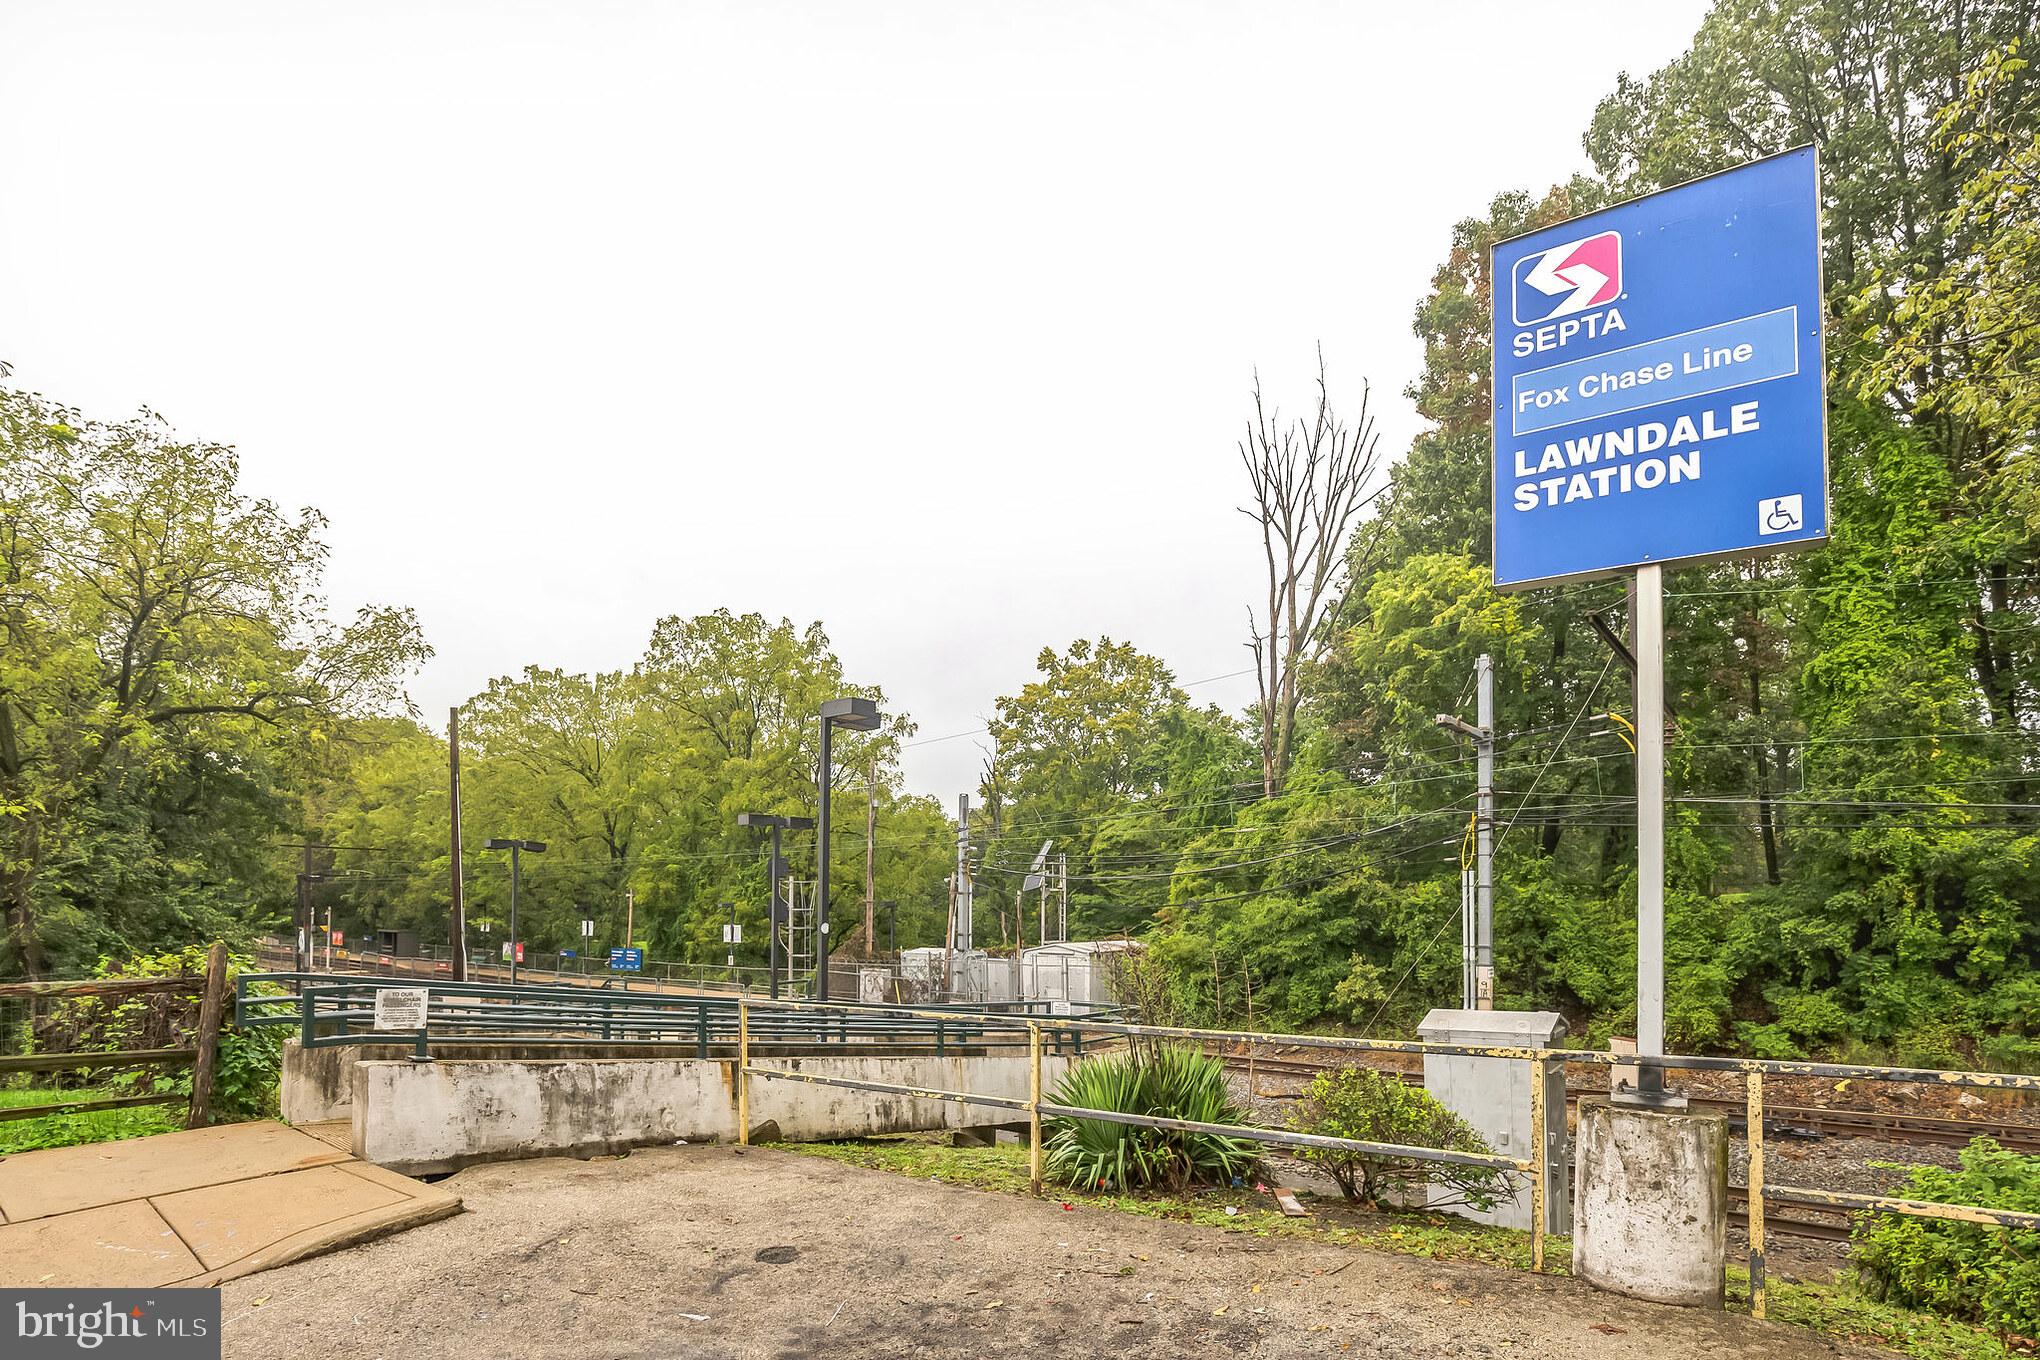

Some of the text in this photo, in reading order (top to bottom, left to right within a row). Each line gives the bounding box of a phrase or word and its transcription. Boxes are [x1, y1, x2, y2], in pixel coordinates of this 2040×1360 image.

[1512, 308, 1627, 358] SEPTA
[1518, 343, 1753, 413] Fox Chase Line
[1514, 400, 1760, 478] LAWNDALE
[1513, 450, 1701, 512] STATION
